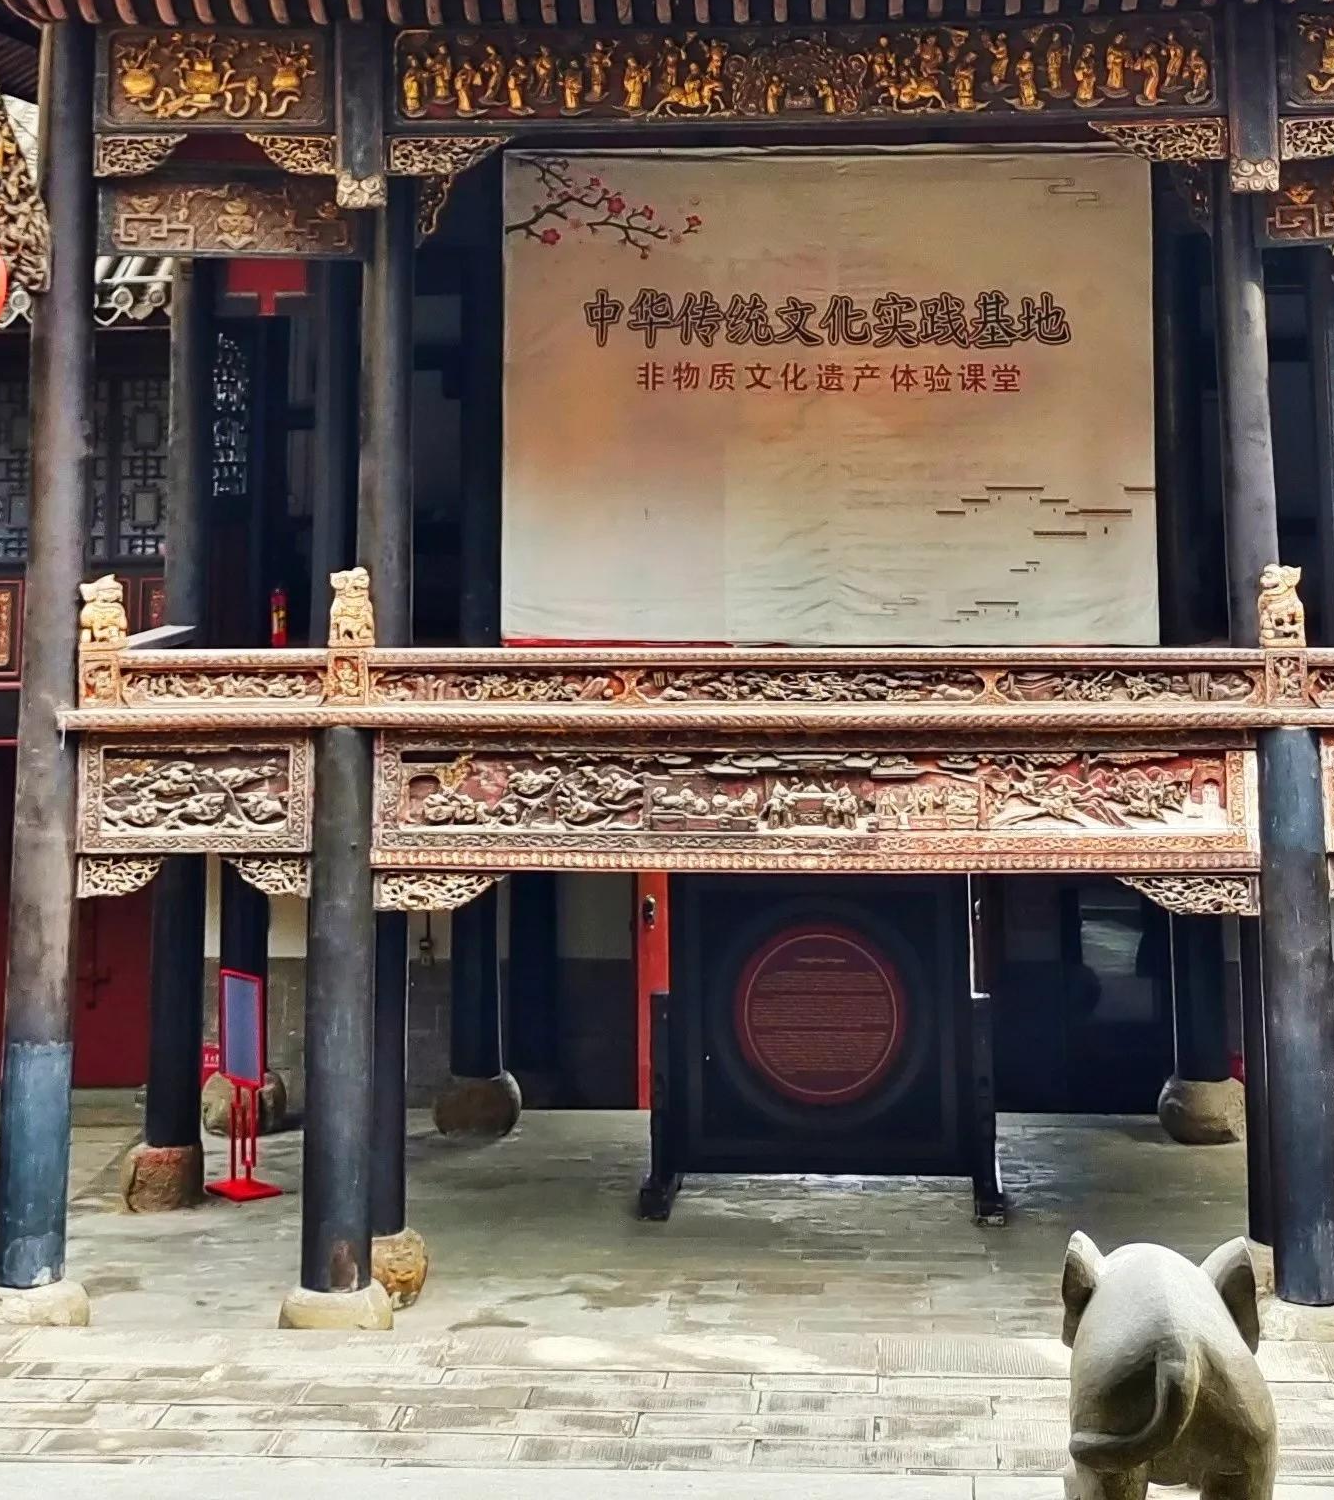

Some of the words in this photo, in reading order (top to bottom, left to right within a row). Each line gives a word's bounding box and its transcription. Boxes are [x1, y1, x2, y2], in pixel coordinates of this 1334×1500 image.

[583, 288, 1072, 350] 中华传统文化实践基地
[636, 361, 1023, 394] 非物质文化遗产体验课堂
